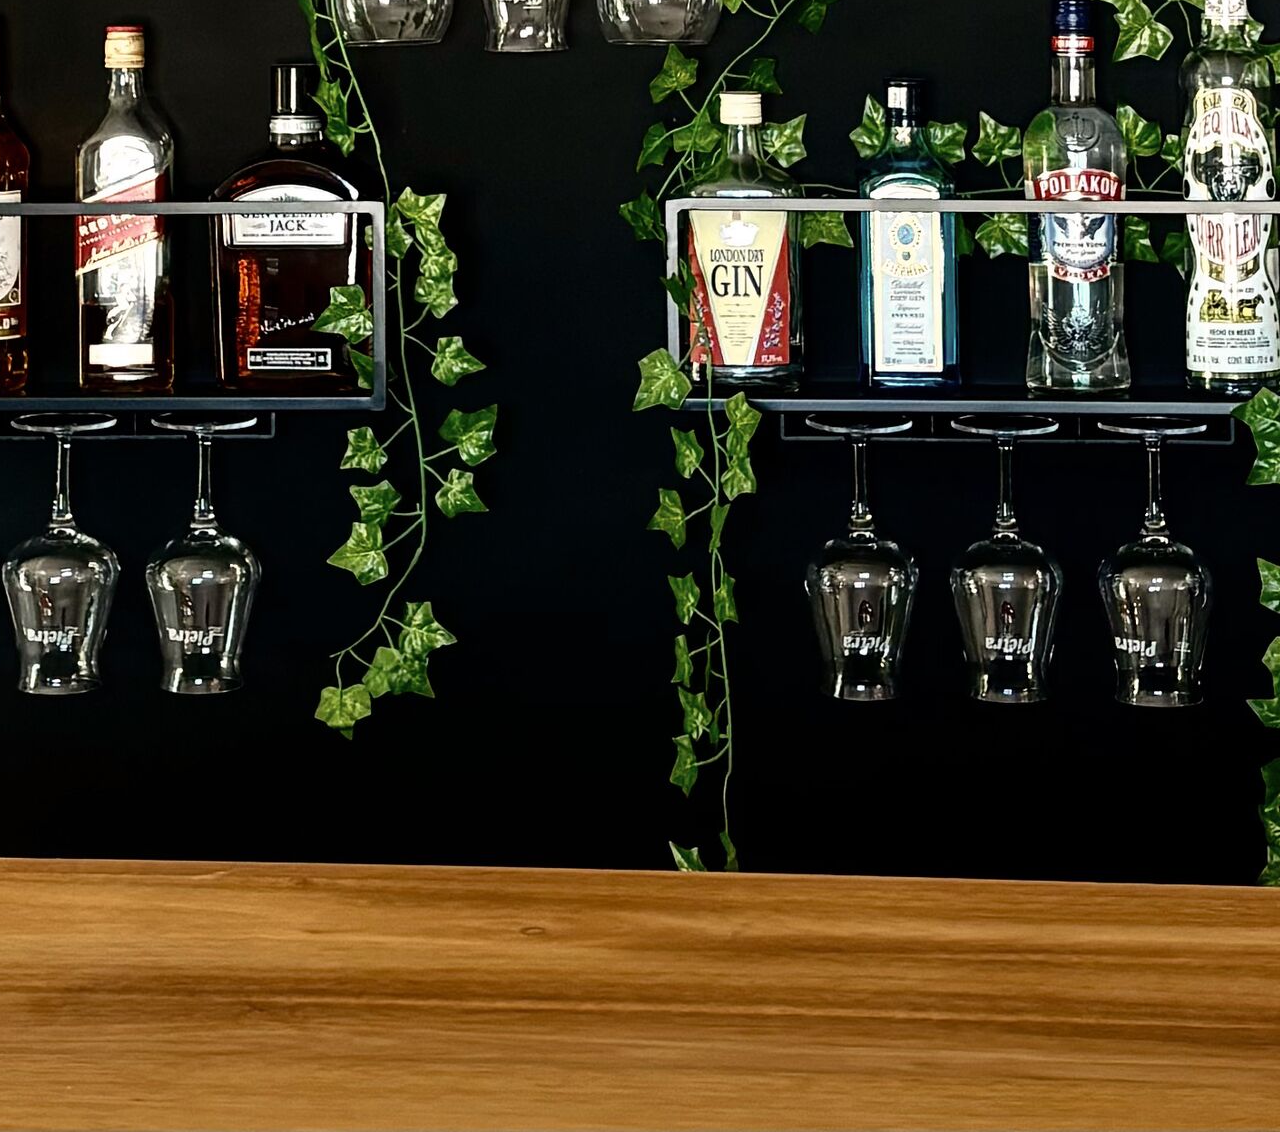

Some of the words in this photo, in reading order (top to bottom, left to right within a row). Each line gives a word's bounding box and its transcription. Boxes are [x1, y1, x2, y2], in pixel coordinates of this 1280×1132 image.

[1198, 111, 1255, 145] EQILA
[1039, 174, 1119, 199] POLIAKOV
[79, 217, 109, 237] RED
[270, 220, 307, 233] JACK
[1196, 214, 1262, 262] CORRLEJO
[710, 249, 746, 263] LONDON
[748, 249, 765, 263] DRY
[711, 264, 764, 298] GIN
[27, 626, 77, 649] Pietra
[166, 626, 216, 649] Pietra
[985, 635, 1035, 655] Pietra
